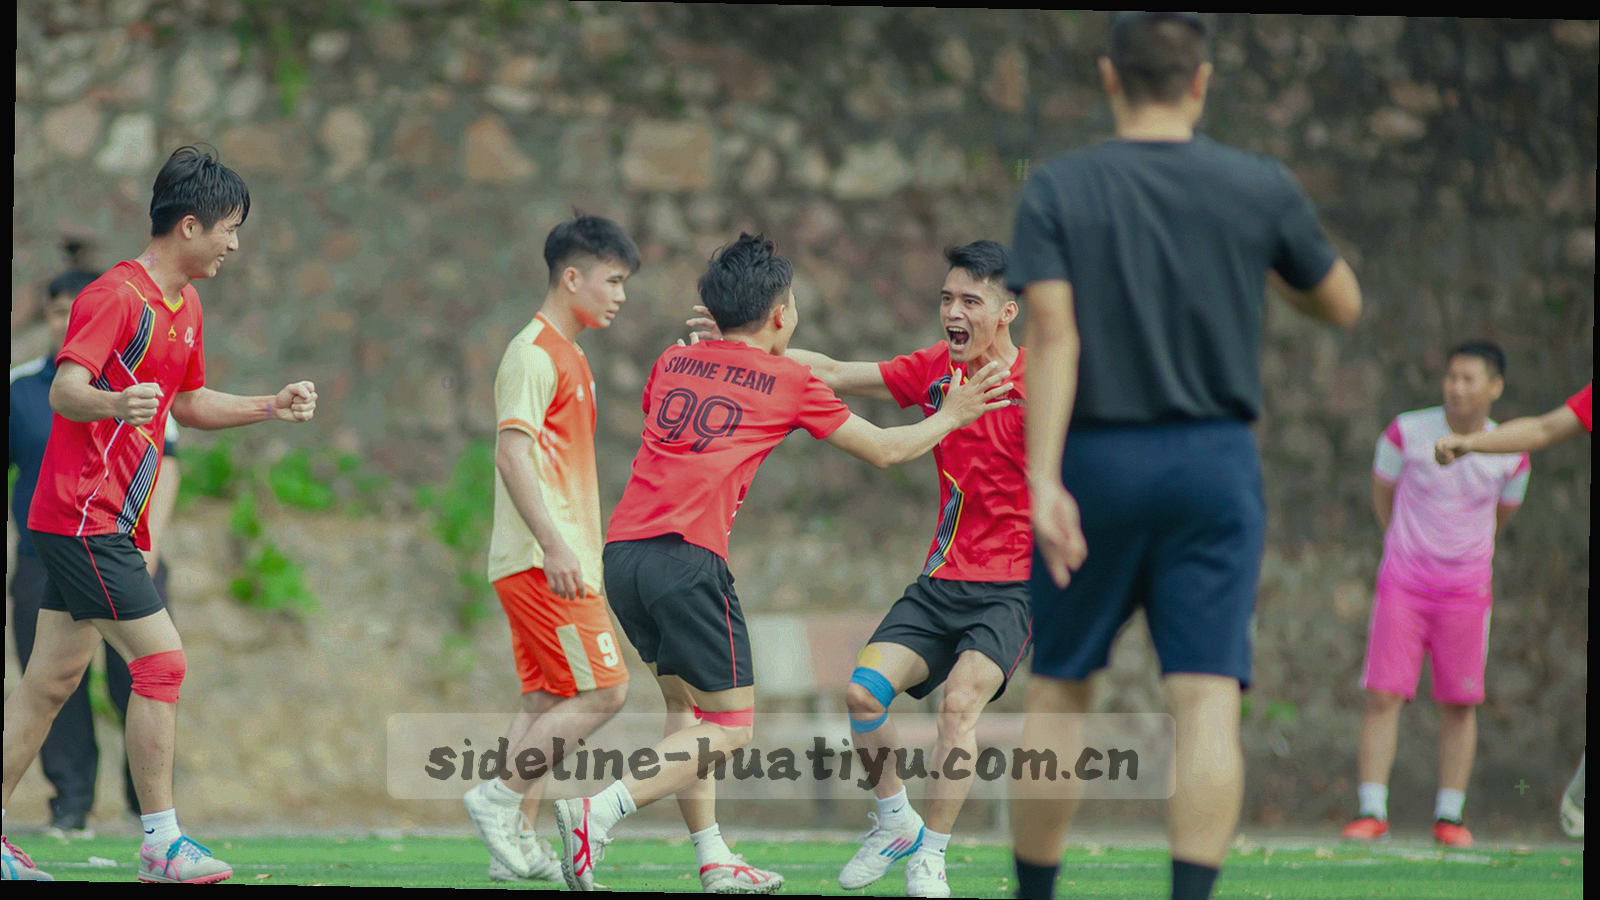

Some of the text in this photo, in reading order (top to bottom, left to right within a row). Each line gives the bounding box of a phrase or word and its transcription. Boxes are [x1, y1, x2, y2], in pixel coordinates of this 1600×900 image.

[664, 356, 776, 395] SWINE TEAM
[656, 388, 742, 452] 99
[596, 631, 618, 668] 9
